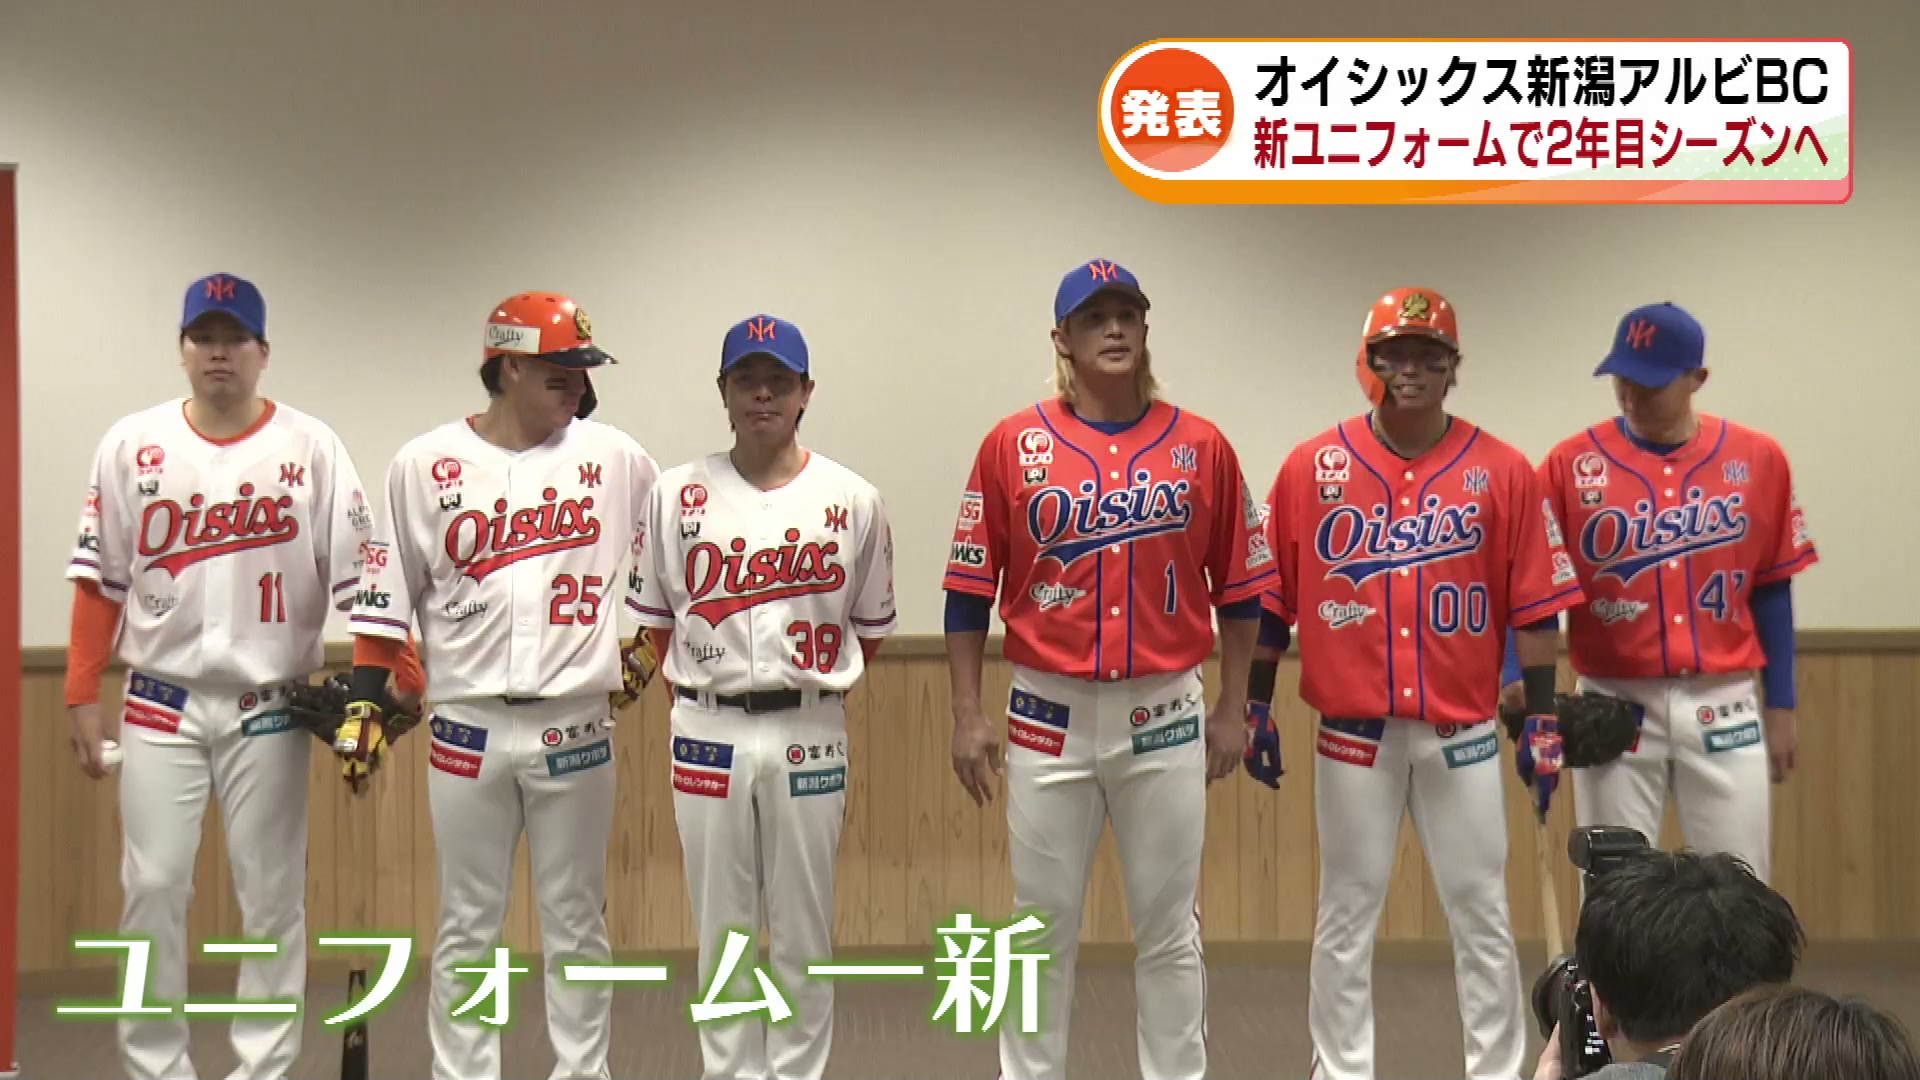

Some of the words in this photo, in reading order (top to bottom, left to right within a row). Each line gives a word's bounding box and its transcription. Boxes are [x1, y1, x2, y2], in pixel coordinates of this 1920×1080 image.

[138, 482, 299, 574] Oisix
[445, 486, 602, 582] Oisix
[1028, 469, 1193, 562] Oisix
[1314, 494, 1484, 586] Oisix
[1578, 486, 1749, 582] Oisix
[258, 571, 288, 624] 11
[549, 573, 603, 626] 25
[684, 527, 847, 624] Oisix
[1164, 560, 1178, 616] 1
[1430, 582, 1488, 636] 00
[786, 620, 843, 674] 38
